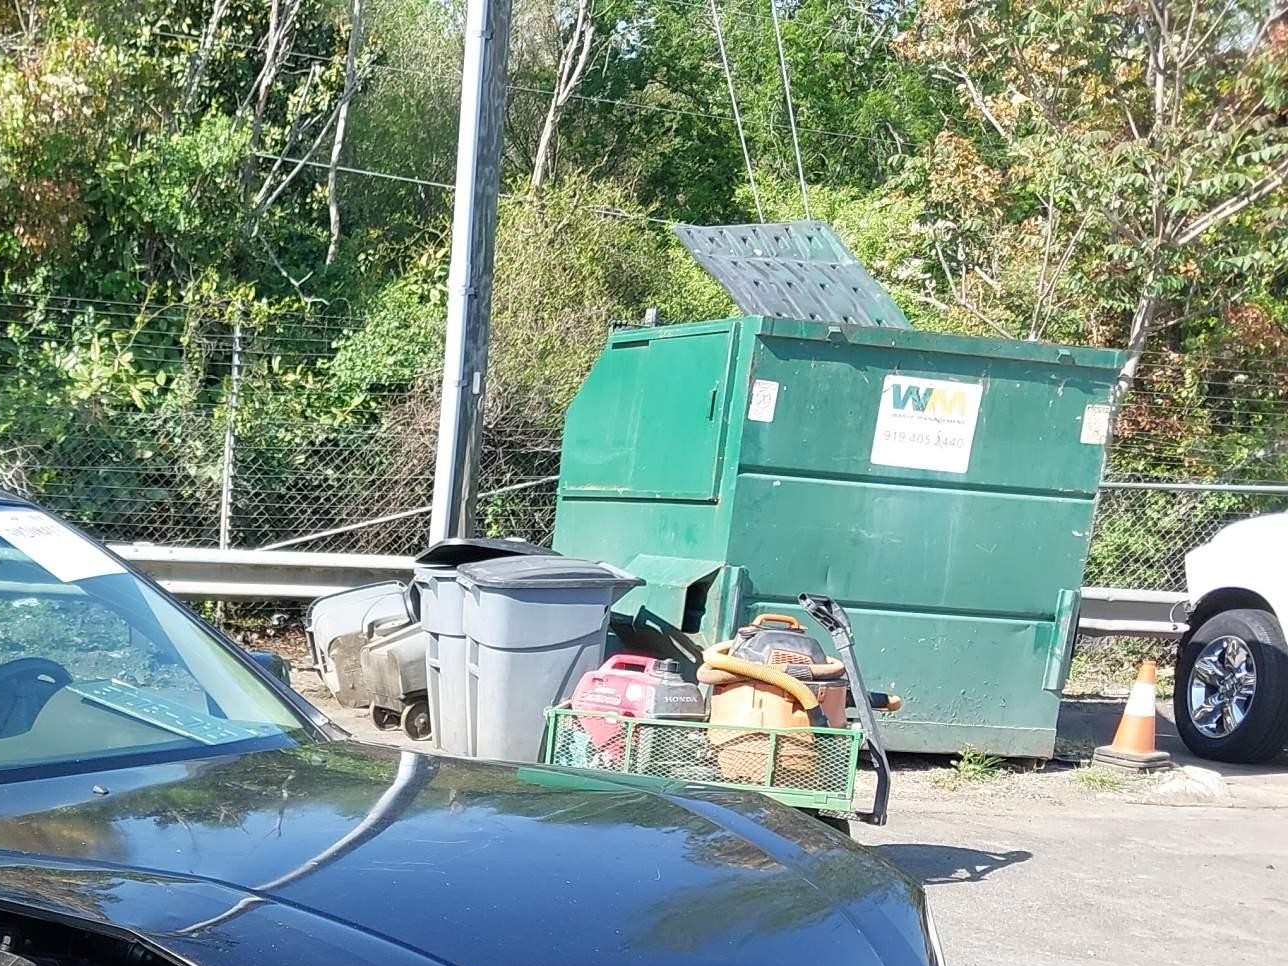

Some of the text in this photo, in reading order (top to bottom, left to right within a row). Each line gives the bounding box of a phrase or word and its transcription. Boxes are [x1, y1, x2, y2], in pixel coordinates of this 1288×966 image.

[892, 384, 966, 417] WM
[884, 430, 906, 442] 919
[909, 433, 931, 446] 405
